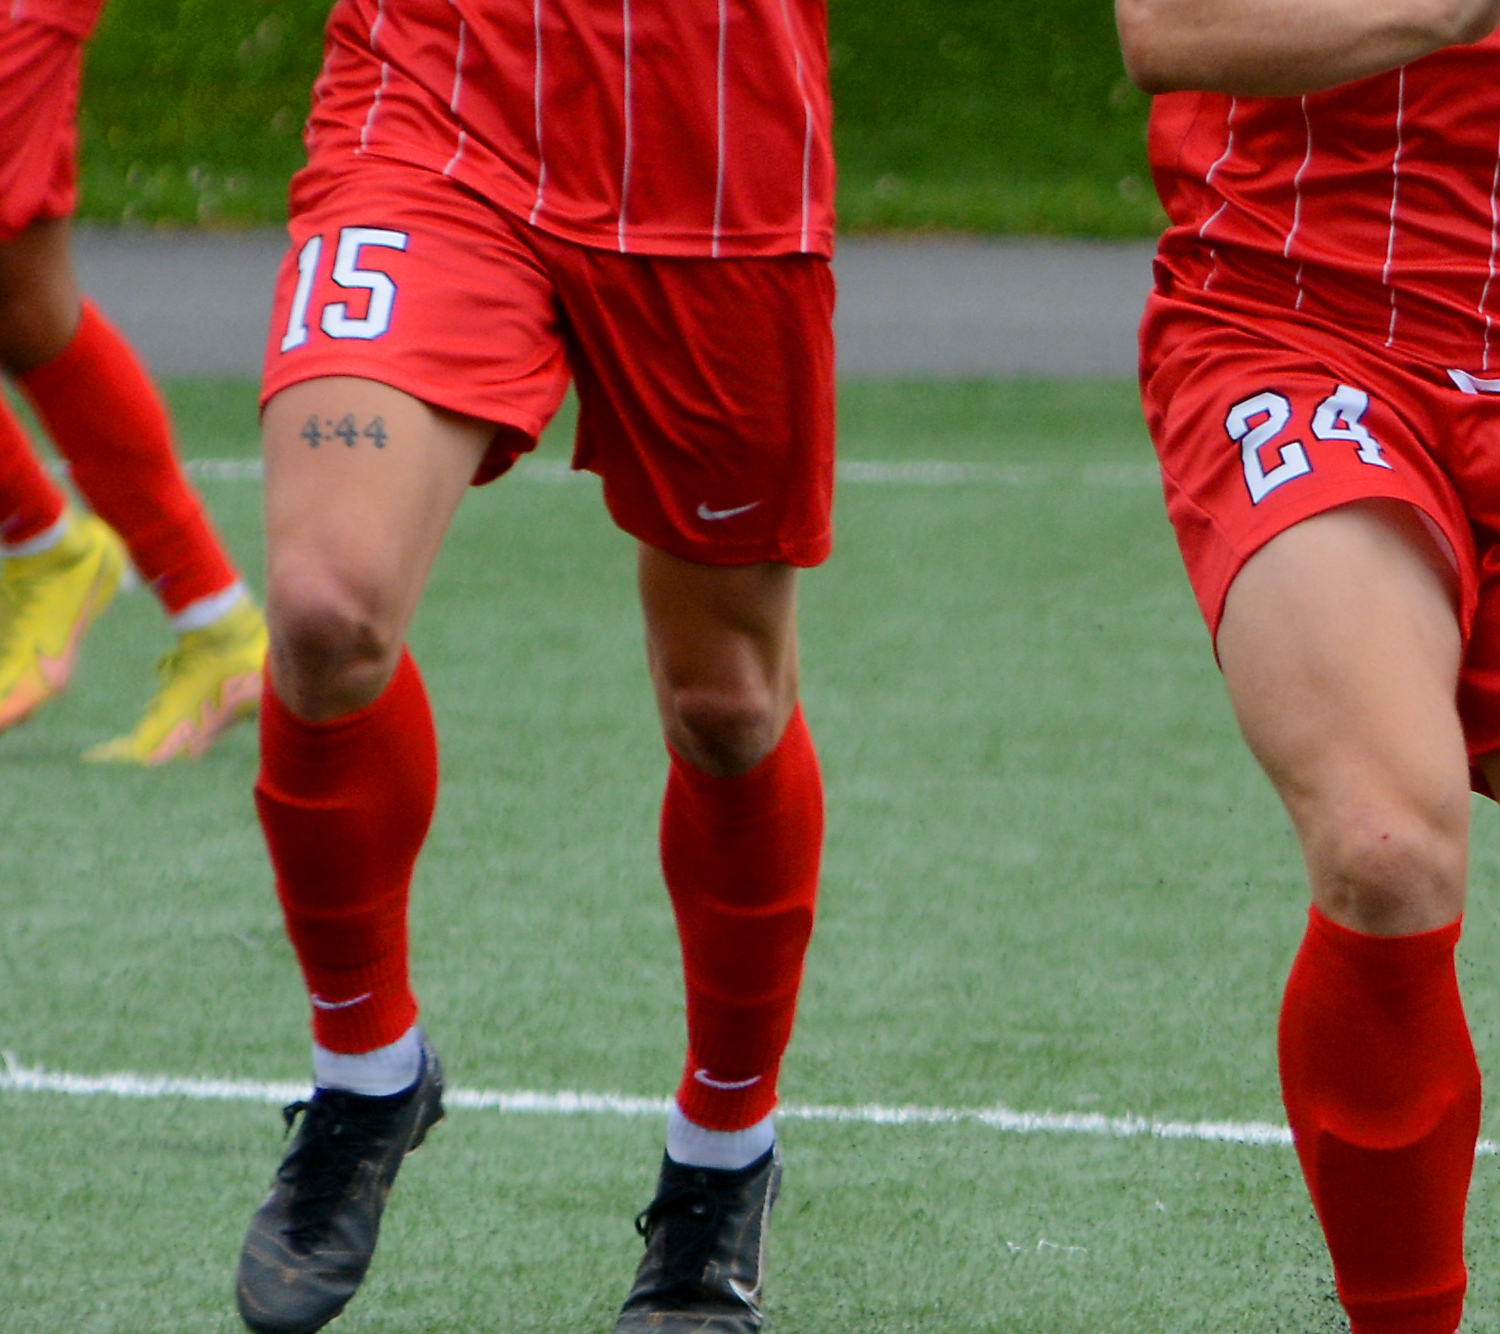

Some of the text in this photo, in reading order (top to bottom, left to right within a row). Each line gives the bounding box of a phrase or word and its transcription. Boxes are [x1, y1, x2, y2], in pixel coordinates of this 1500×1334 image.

[280, 225, 410, 355] 15
[301, 414, 388, 450] 4:44
[1224, 383, 1396, 507] 24
